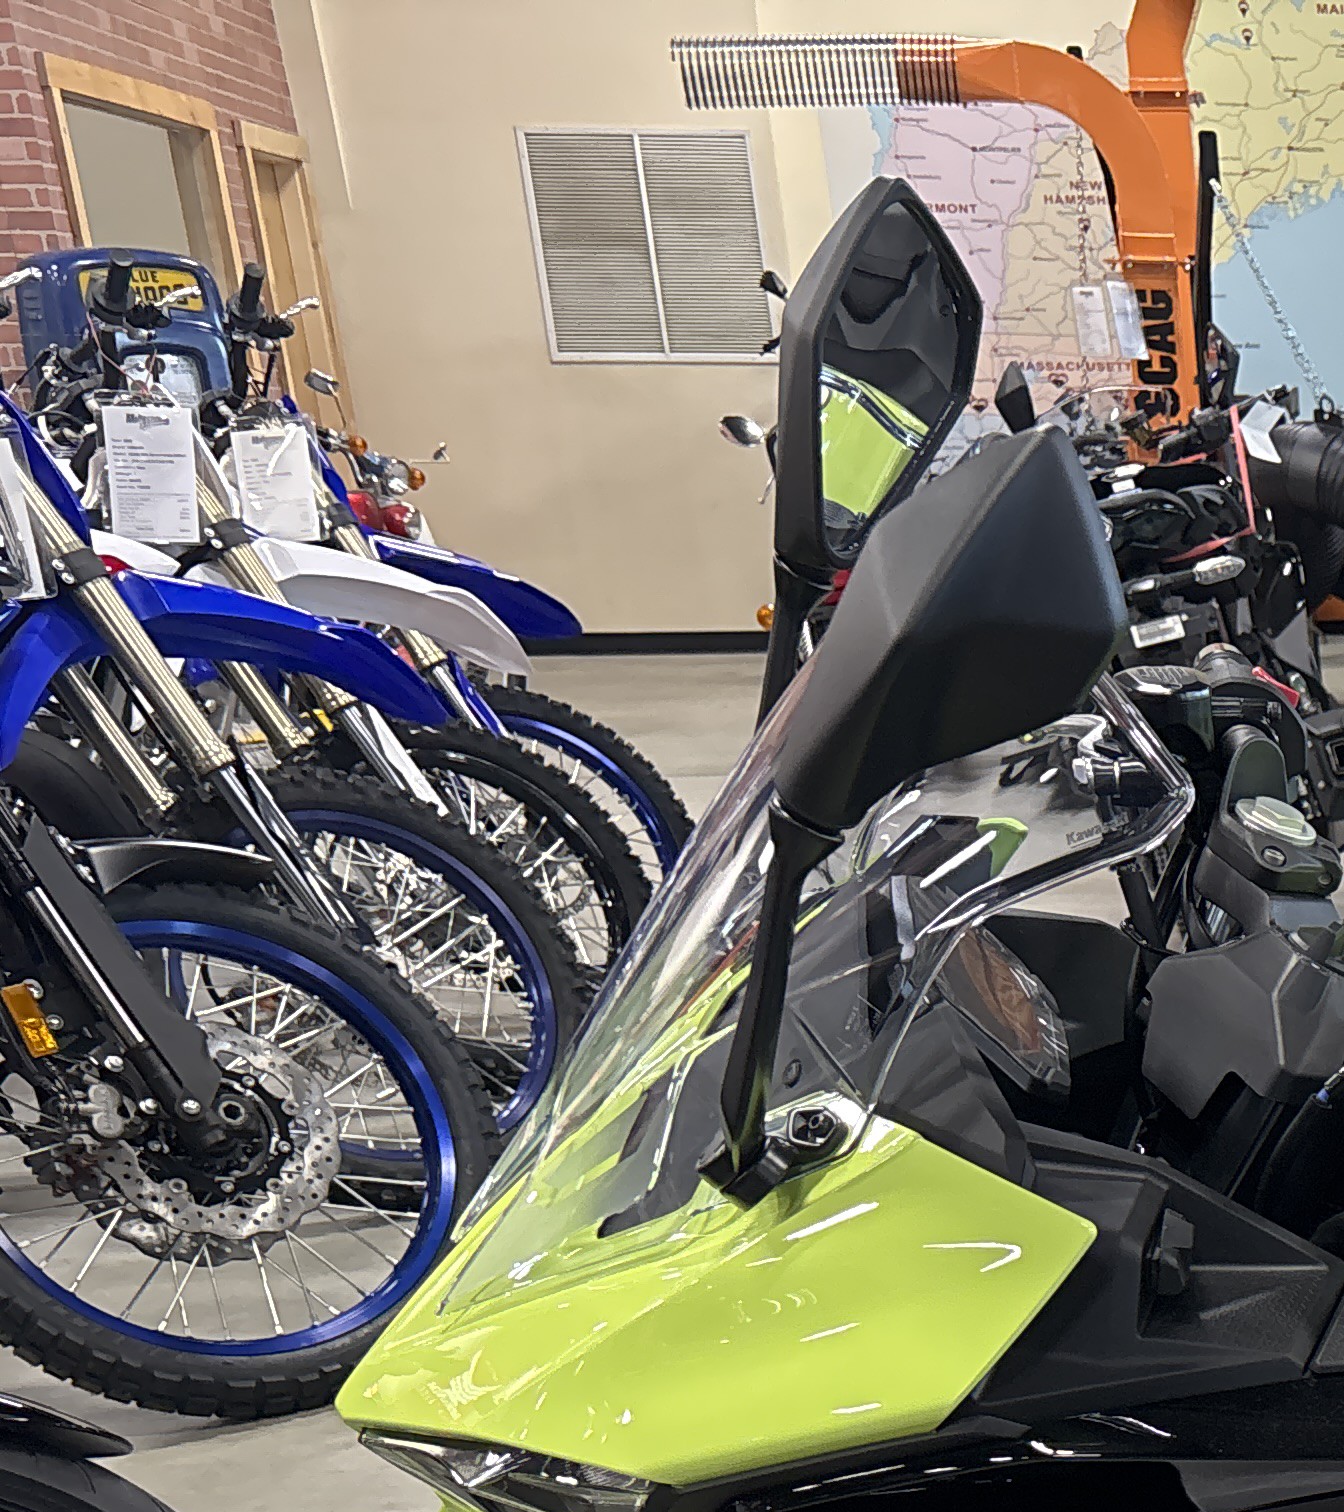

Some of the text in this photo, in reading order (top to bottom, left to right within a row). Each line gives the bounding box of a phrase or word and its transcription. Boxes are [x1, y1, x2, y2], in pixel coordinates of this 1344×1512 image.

[1069, 180, 1103, 191] NEW
[928, 203, 978, 214] RMONT
[131, 269, 160, 284] LUE
[1018, 361, 1132, 373] MASSACHUSETT
